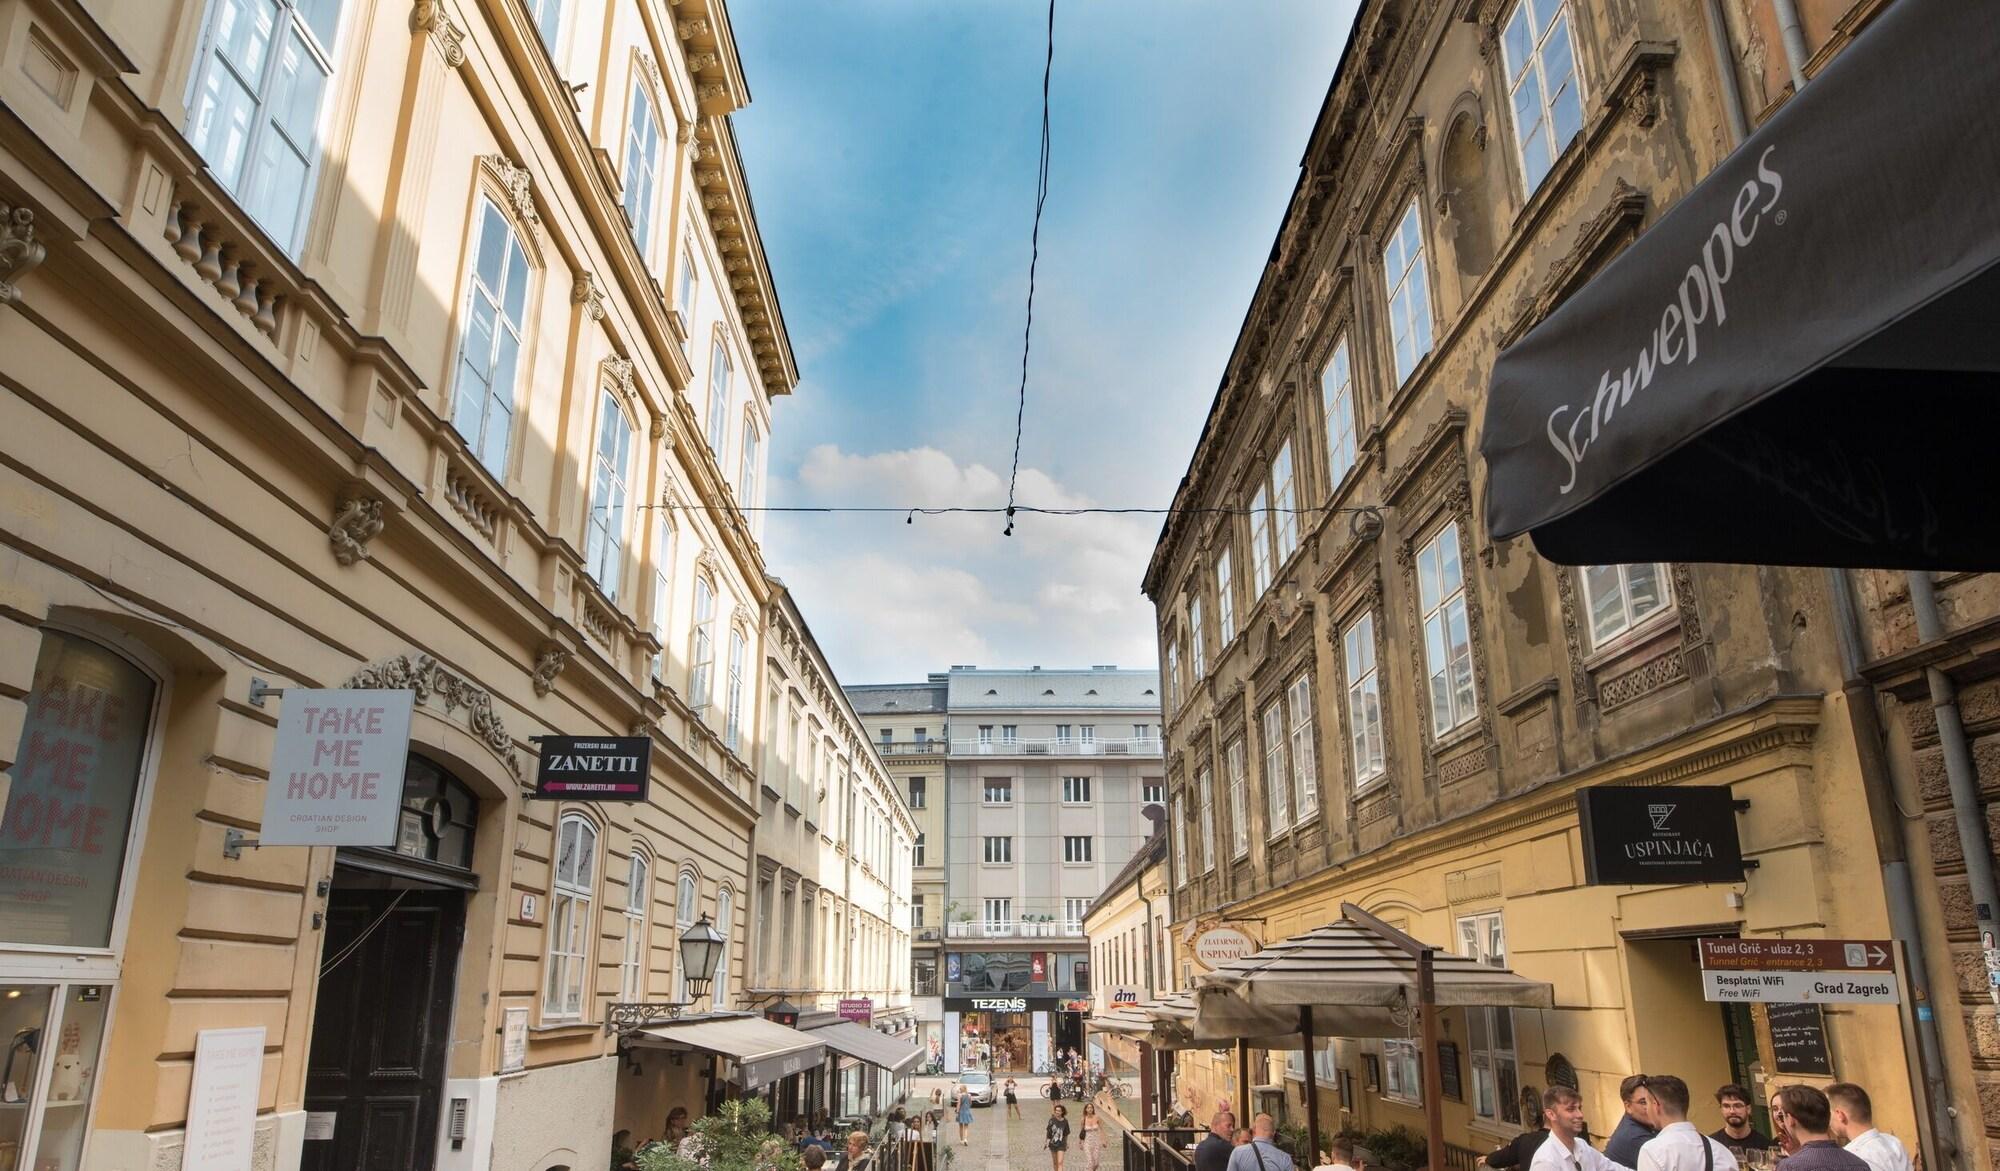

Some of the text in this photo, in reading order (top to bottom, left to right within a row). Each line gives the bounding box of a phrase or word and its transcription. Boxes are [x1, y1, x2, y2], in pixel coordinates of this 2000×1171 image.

[1547, 144, 1783, 494] Schweppes
[36, 670, 122, 742] AKE
[304, 707, 385, 734] TAKE
[20, 729, 95, 791] ME
[312, 740, 363, 767] ME
[548, 755, 639, 772] ZANETTI
[287, 772, 380, 800] HOME
[290, 814, 367, 822] CROATIAN DESIGN
[316, 825, 338, 833] SHOP
[1624, 839, 1714, 859] USPINJAČA
[1707, 943, 1737, 955] Tunel
[1739, 942, 1761, 955] Grič
[1771, 943, 1793, 955] ulaz
[1795, 944, 1805, 957] 2,
[1807, 944, 1814, 954] 3
[1709, 957, 1738, 966] Tunnel
[1740, 957, 1758, 966] Grič
[1766, 958, 1805, 967] entrance
[1818, 958, 1823, 967] 3
[1717, 975, 1785, 987] Besplatni WiFi
[1114, 988, 1136, 1002] dm
[1719, 988, 1760, 998] Free WiFi
[1814, 983, 1889, 996] Grad Zagreb
[971, 997, 1026, 1009] TEZENIS
